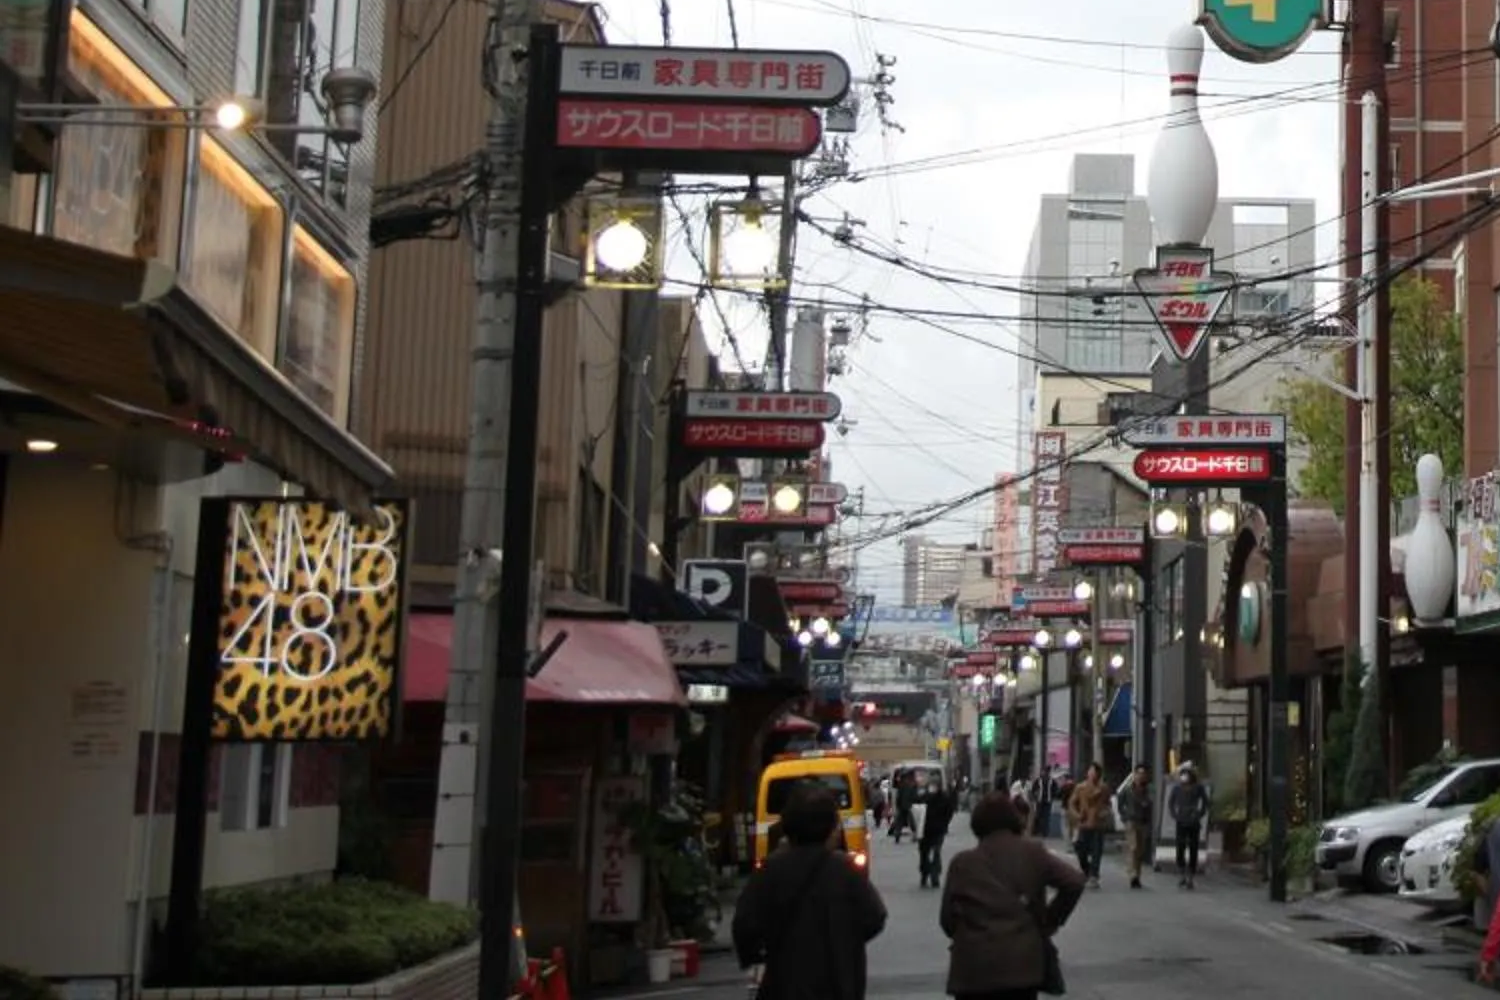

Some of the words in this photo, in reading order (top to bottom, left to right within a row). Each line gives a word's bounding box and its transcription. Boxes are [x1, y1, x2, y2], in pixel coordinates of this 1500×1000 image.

[578, 59, 641, 82] 千日前
[652, 57, 826, 91] 家具専門街
[566, 106, 805, 144] サウスロード千日前
[229, 503, 397, 592] NMB
[221, 591, 337, 681] 48
